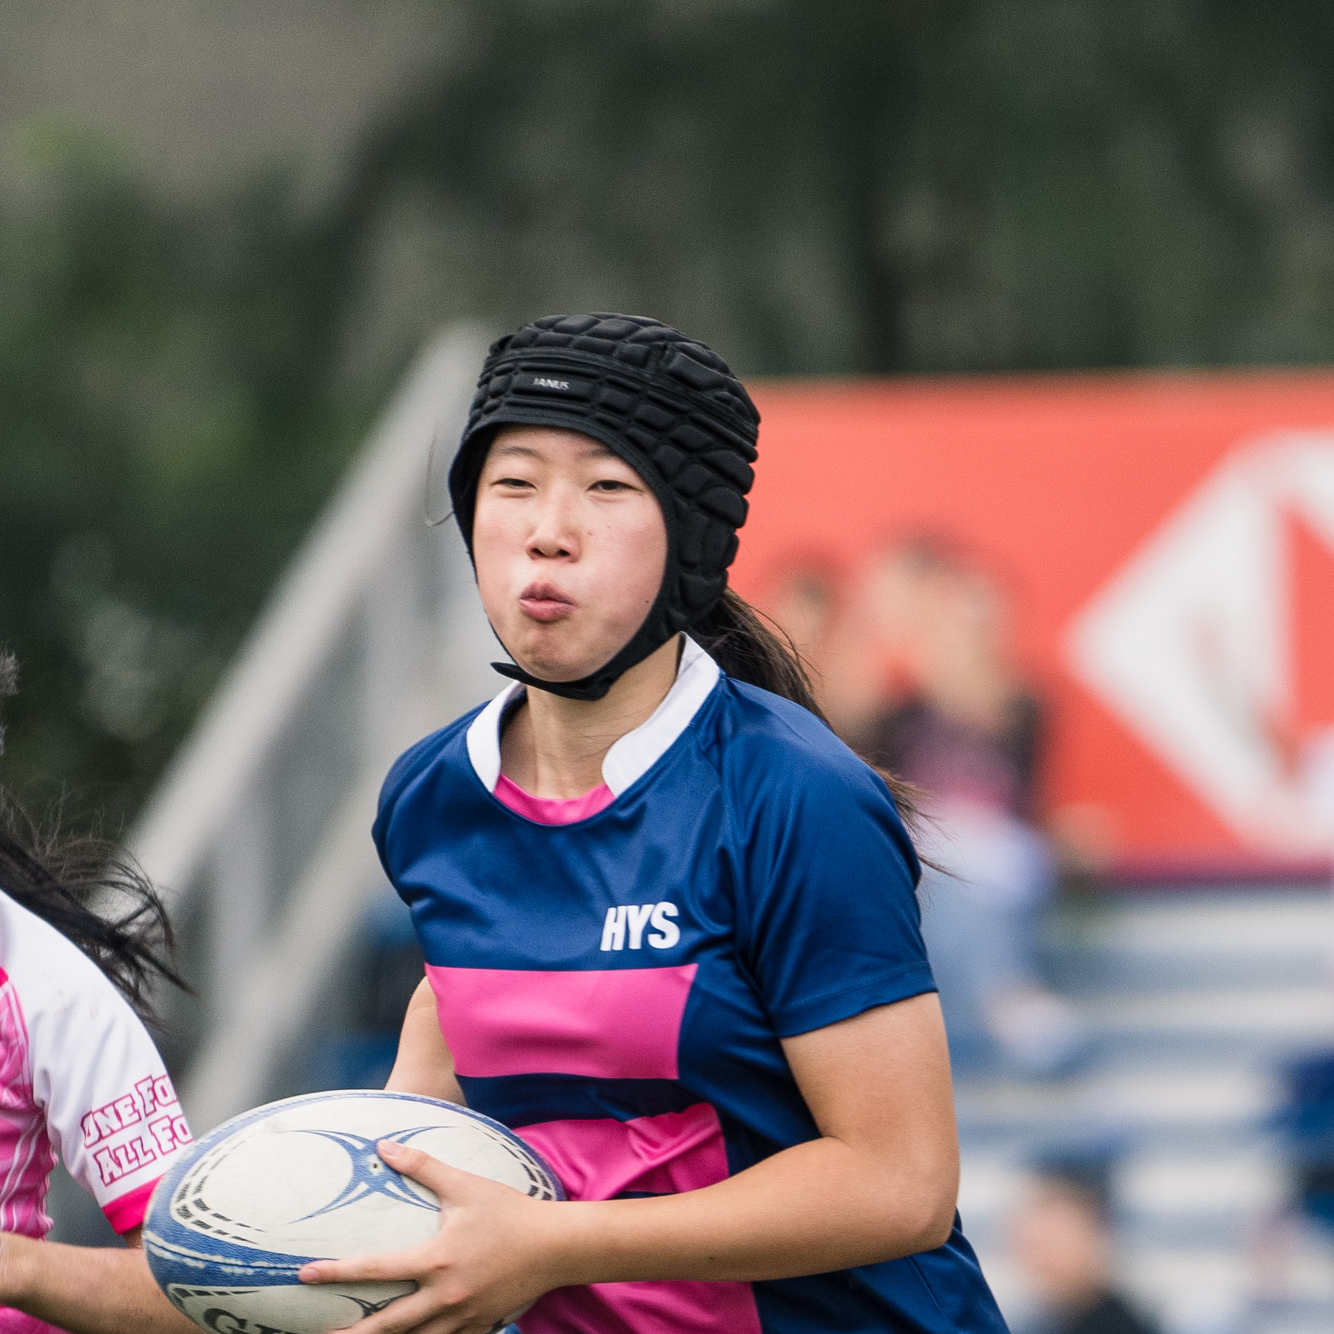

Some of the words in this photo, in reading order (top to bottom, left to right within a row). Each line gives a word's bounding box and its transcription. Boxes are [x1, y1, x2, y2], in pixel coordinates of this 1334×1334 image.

[599, 901, 681, 952] HYS
[80, 1092, 142, 1149] ONE
[134, 1073, 179, 1118] FO
[92, 1136, 157, 1187] ALL
[148, 1114, 195, 1156] FO
